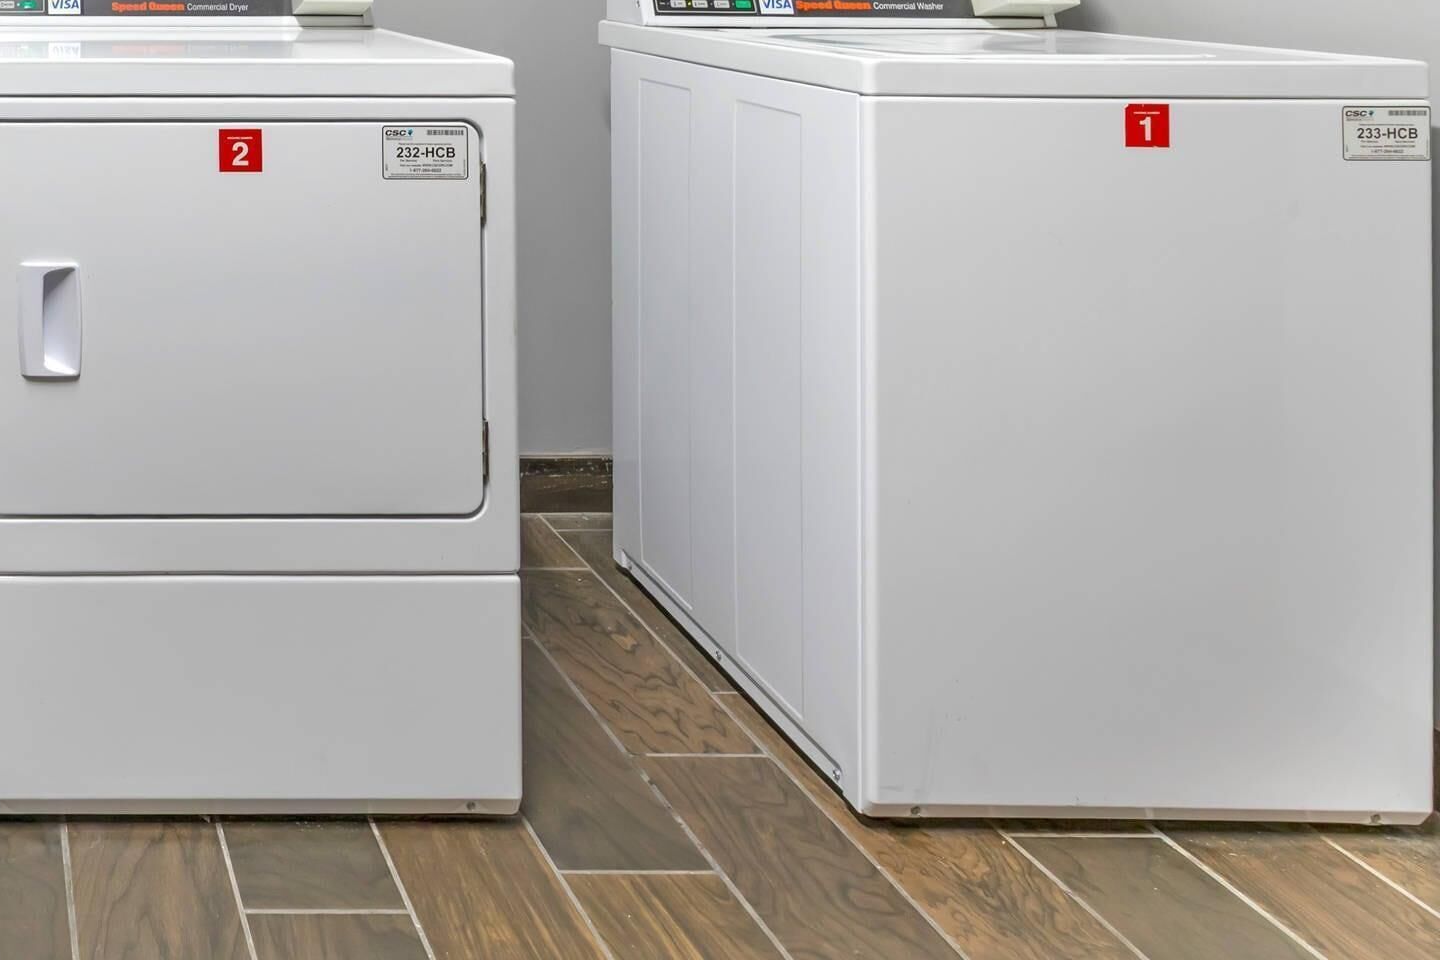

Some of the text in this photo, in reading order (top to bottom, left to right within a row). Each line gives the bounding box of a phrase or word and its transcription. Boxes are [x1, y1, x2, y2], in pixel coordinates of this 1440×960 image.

[52, 0, 79, 9] VISA
[112, 2, 249, 13] Speed Queen Commercial Dryer
[763, 0, 792, 9] VISA
[795, 0, 944, 11] Speed Queen Commercial Washer
[1139, 116, 1152, 141] 1
[1357, 127, 1418, 139] 233-HCB
[232, 141, 249, 166] 2
[396, 146, 456, 158] 232-HCB
